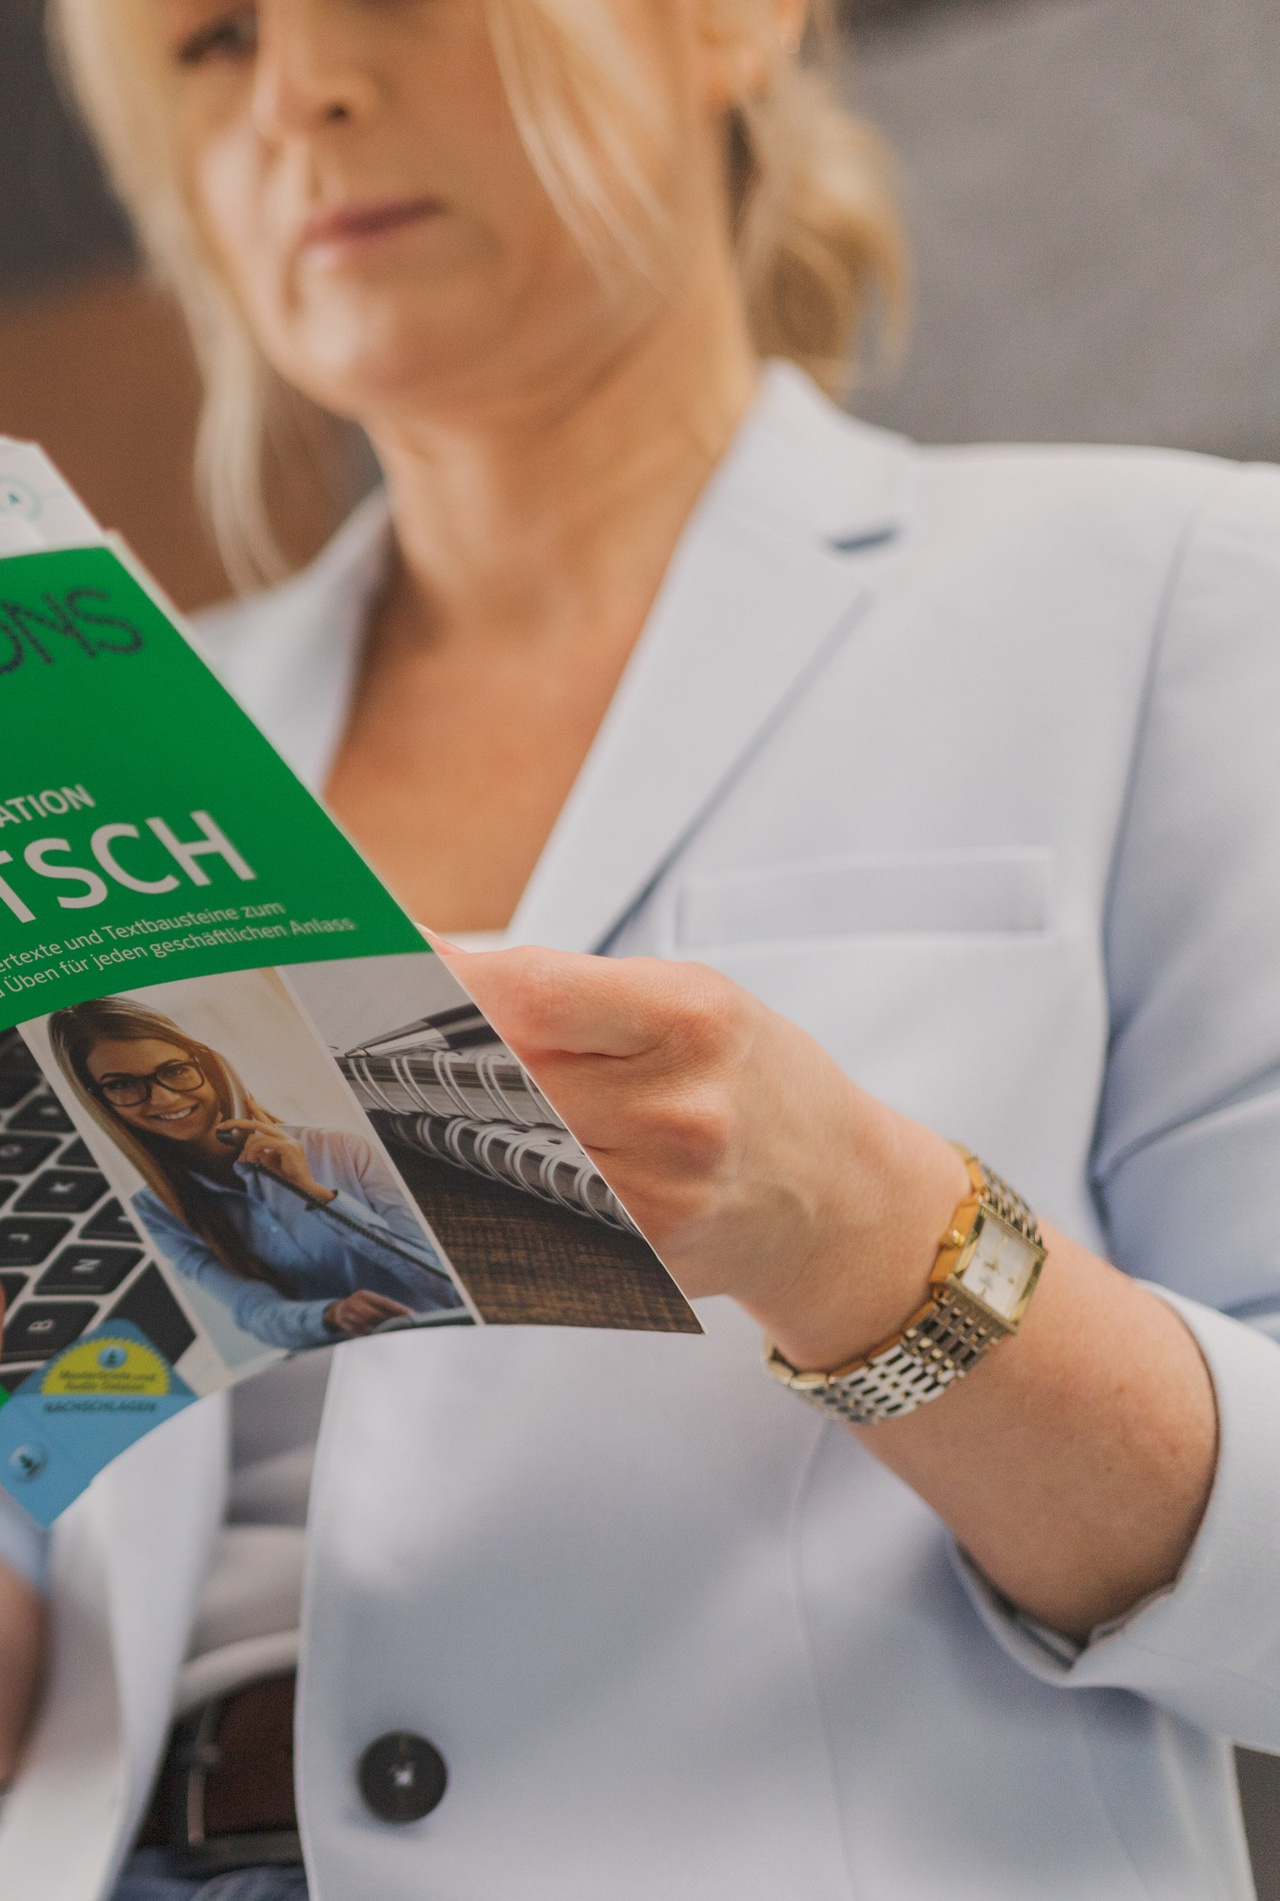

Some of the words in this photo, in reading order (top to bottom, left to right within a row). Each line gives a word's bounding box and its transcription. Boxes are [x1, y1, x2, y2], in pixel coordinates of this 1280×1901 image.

[3, 963, 52, 993] Üben
[59, 956, 90, 976] für
[92, 943, 149, 972] jeden
[150, 921, 288, 959] geschäftlichen
[289, 916, 358, 936] Anlass
[64, 928, 104, 952] und
[101, 905, 239, 941] Textbausteine
[239, 901, 286, 919] zum
